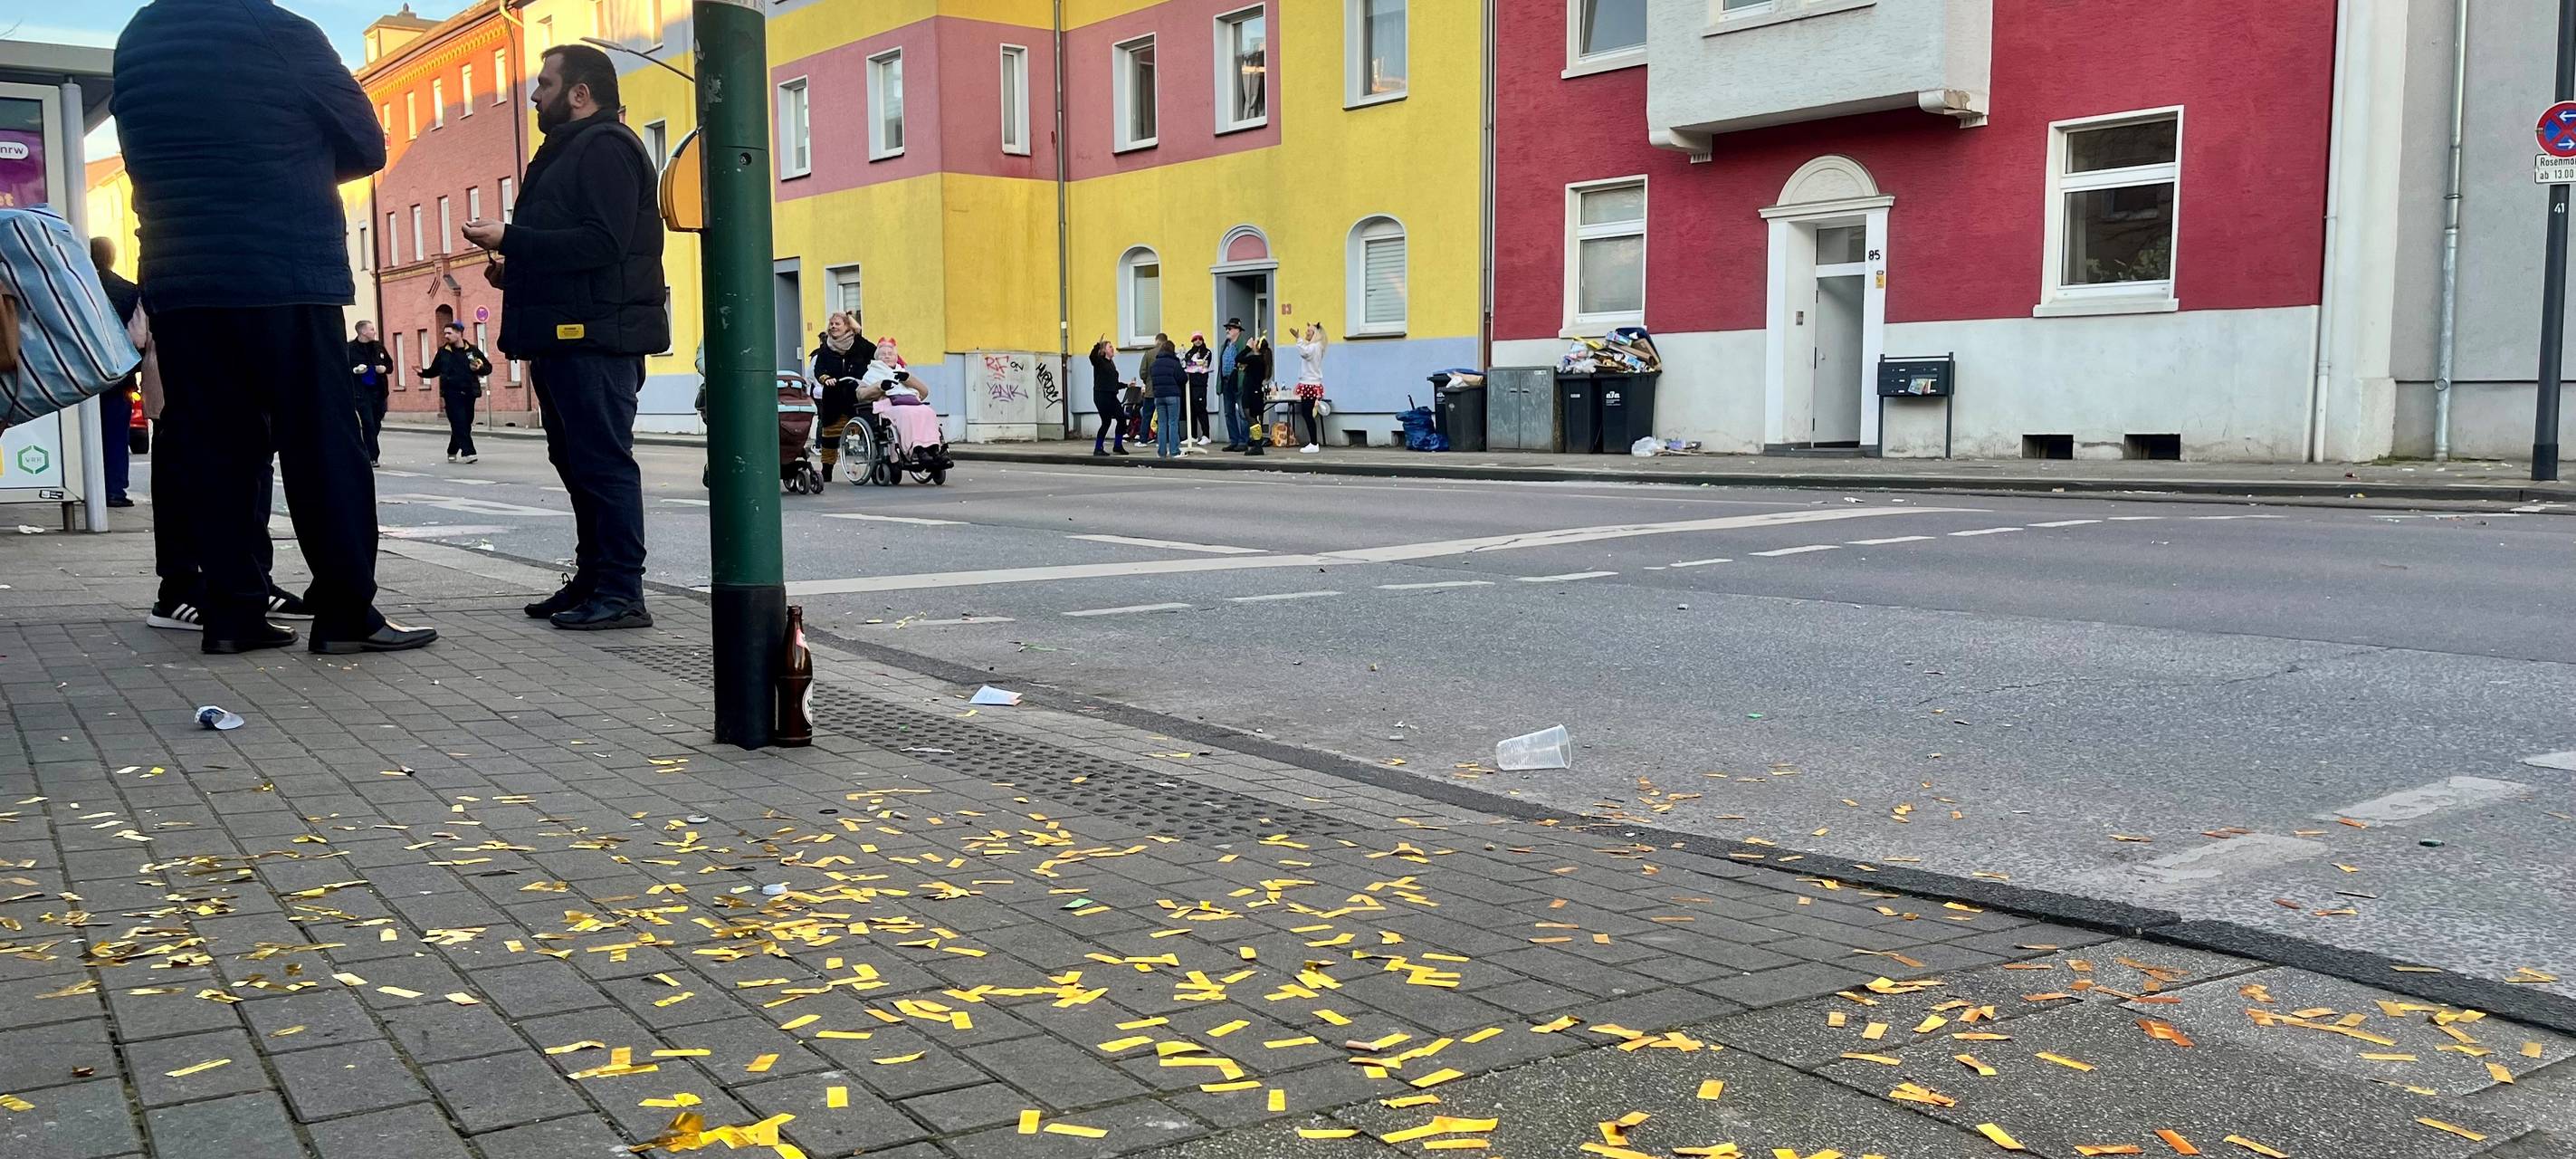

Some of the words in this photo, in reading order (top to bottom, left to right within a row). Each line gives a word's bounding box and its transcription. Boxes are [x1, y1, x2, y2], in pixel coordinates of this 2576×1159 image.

[2540, 170, 2549, 180] ab
[2554, 202, 2565, 214] 41
[1868, 249, 1881, 261] 85
